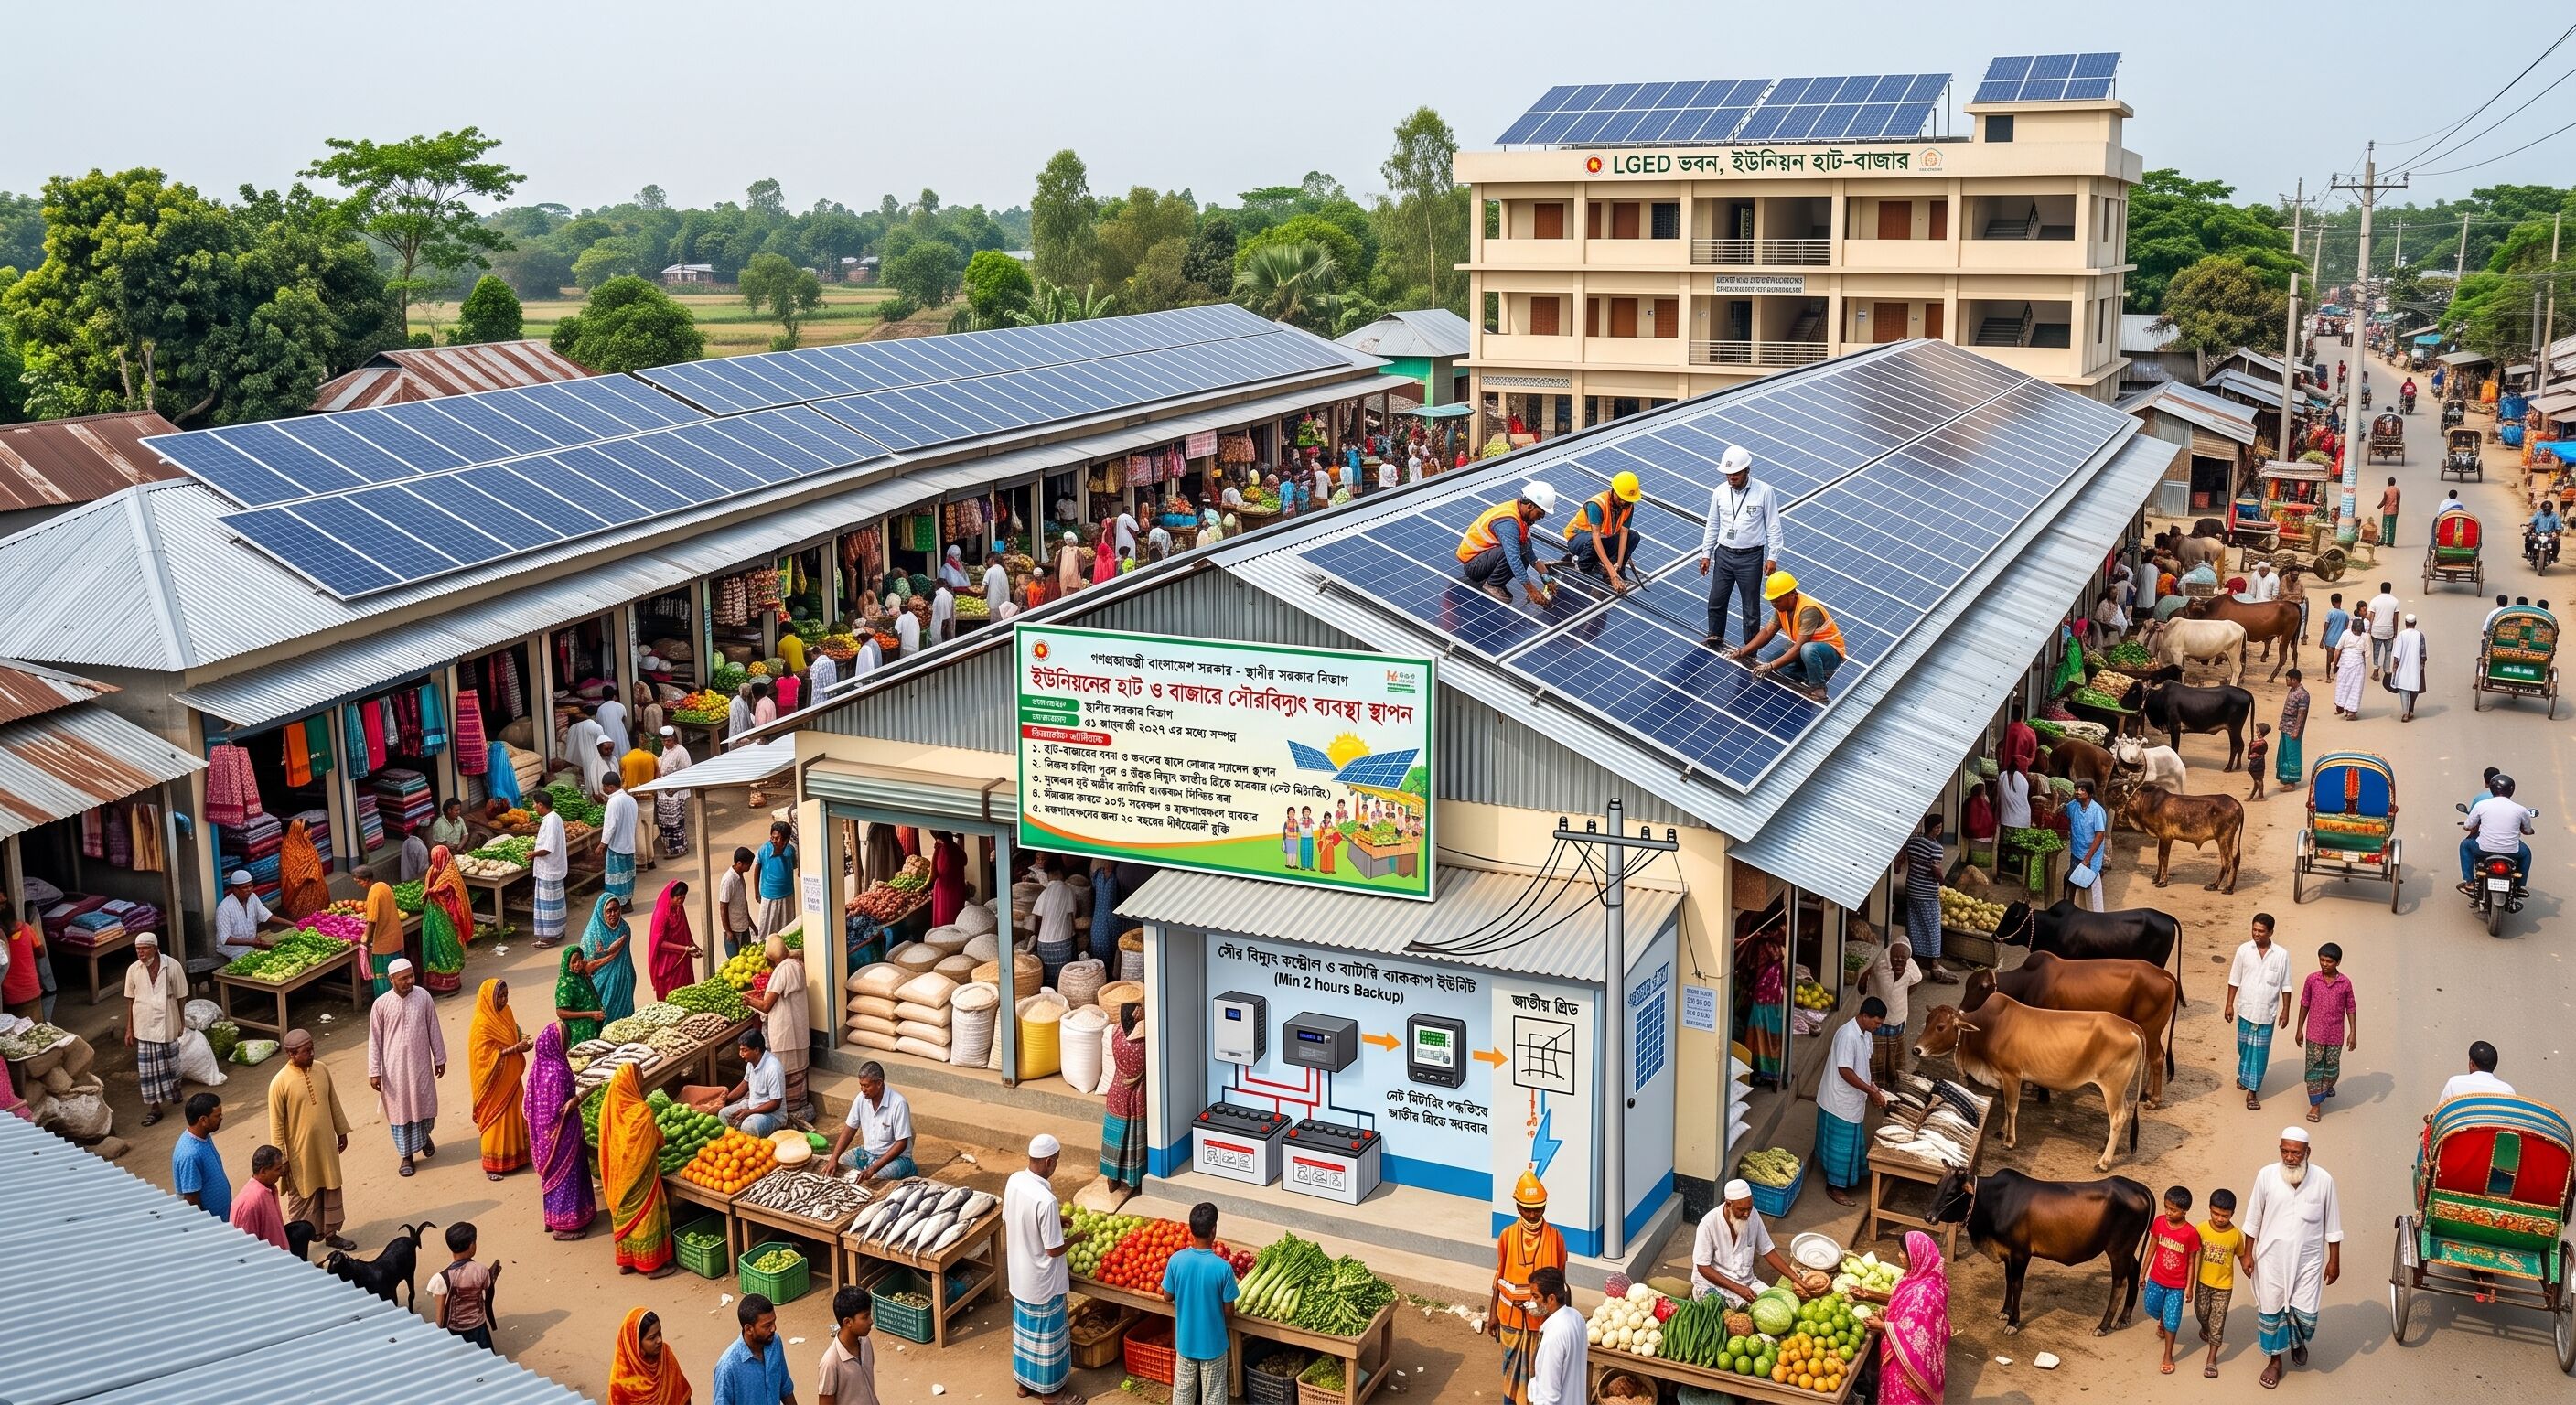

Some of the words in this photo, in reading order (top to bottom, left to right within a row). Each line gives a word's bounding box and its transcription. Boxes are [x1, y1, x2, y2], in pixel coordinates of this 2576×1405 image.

[1615, 156, 1670, 174] LGED
[1678, 156, 1723, 175] ভবন,
[1731, 149, 1807, 173] ইউনিয়ন
[1811, 147, 1910, 172] হাট-বাজার
[1031, 665, 1111, 693] ইউনিয়নের
[1115, 675, 1143, 698] হাট
[1150, 683, 1162, 698] ও
[1167, 683, 1223, 705] বাজারে
[1229, 684, 1307, 717] সৌরবিদ্যুৎ
[1313, 698, 1362, 724] ব্যবস্থা
[1368, 702, 1413, 725] স্থাপন
[1140, 724, 1165, 735] ২০২৭
[1033, 745, 1040, 753] ১.
[1033, 760, 1041, 768] ২.
[1105, 798, 1125, 807] ১০%
[1122, 815, 1132, 823] ২০
[1326, 962, 1335, 972] ও
[1275, 972, 1300, 987] (Min
[1304, 976, 1311, 988] 2
[1315, 978, 1349, 994] hours
[1355, 984, 1403, 1005] Backup)
